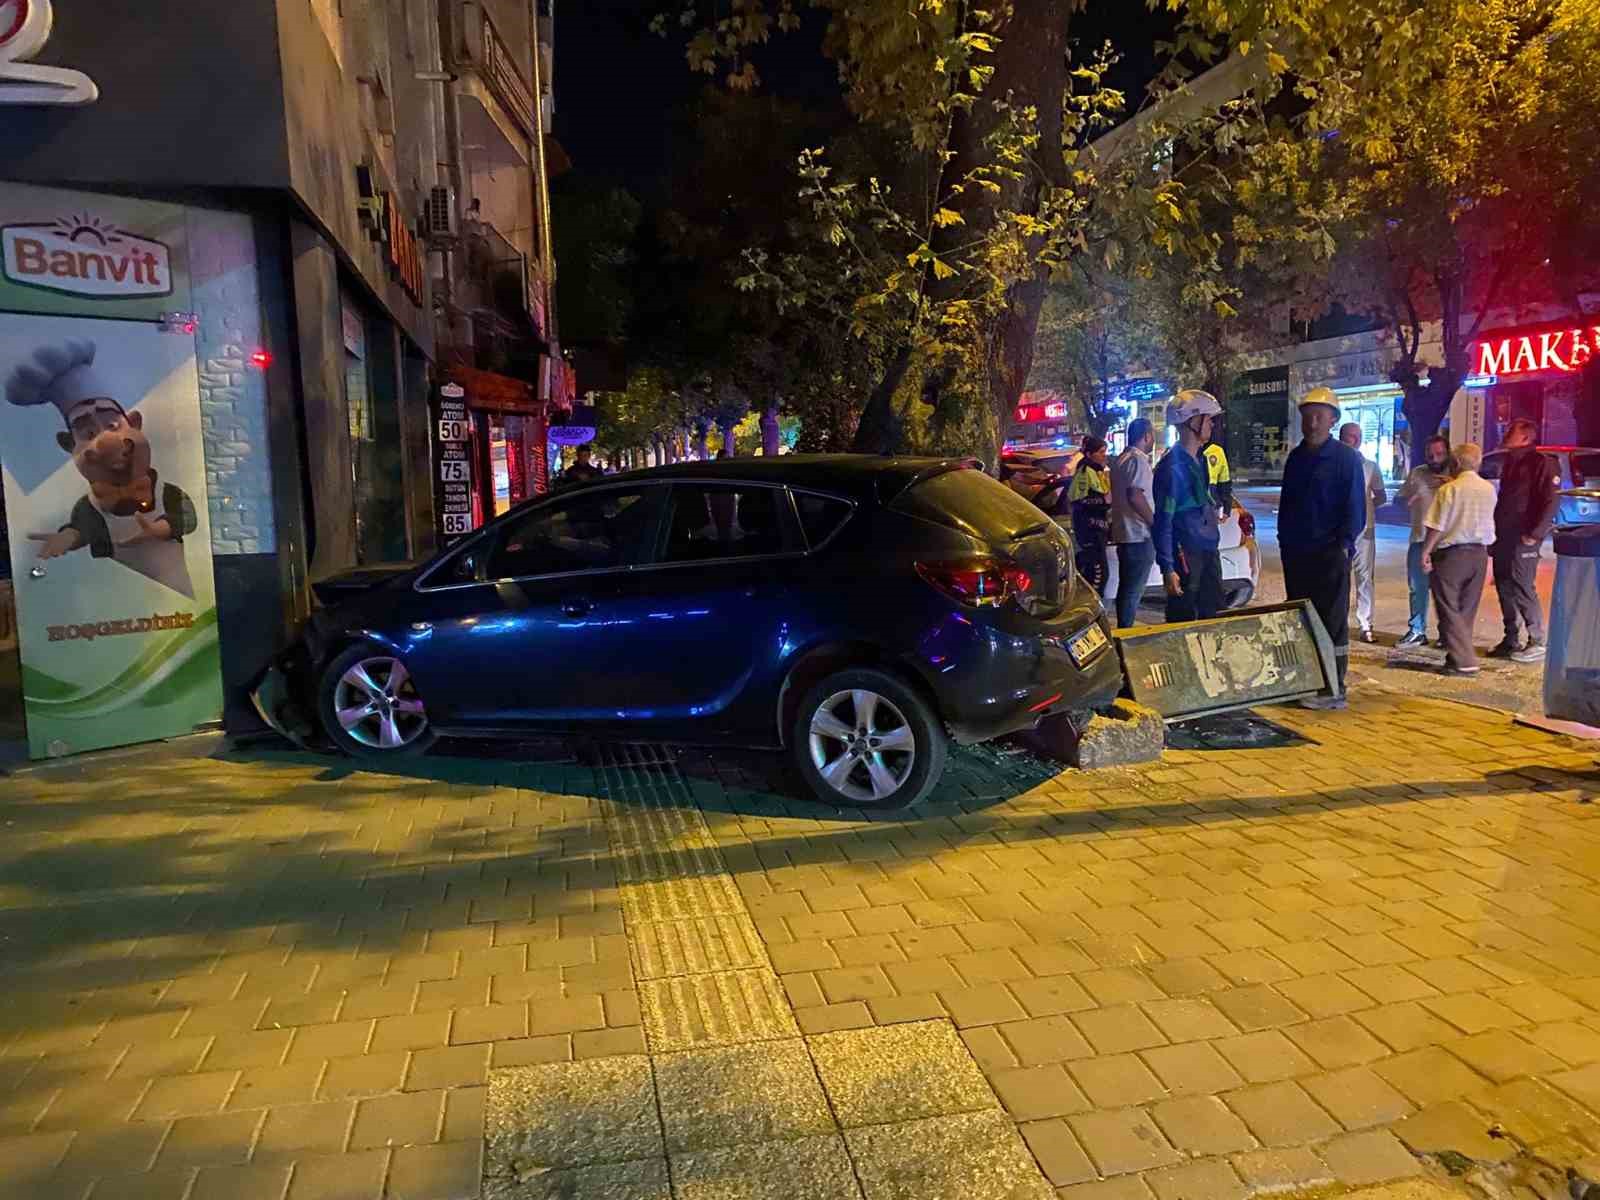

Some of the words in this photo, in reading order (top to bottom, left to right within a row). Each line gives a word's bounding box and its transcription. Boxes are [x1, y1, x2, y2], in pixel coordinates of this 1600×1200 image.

[14, 237, 161, 285] Banvit
[441, 422, 460, 439] 50
[442, 462, 461, 479] 75
[445, 515, 465, 532] 85
